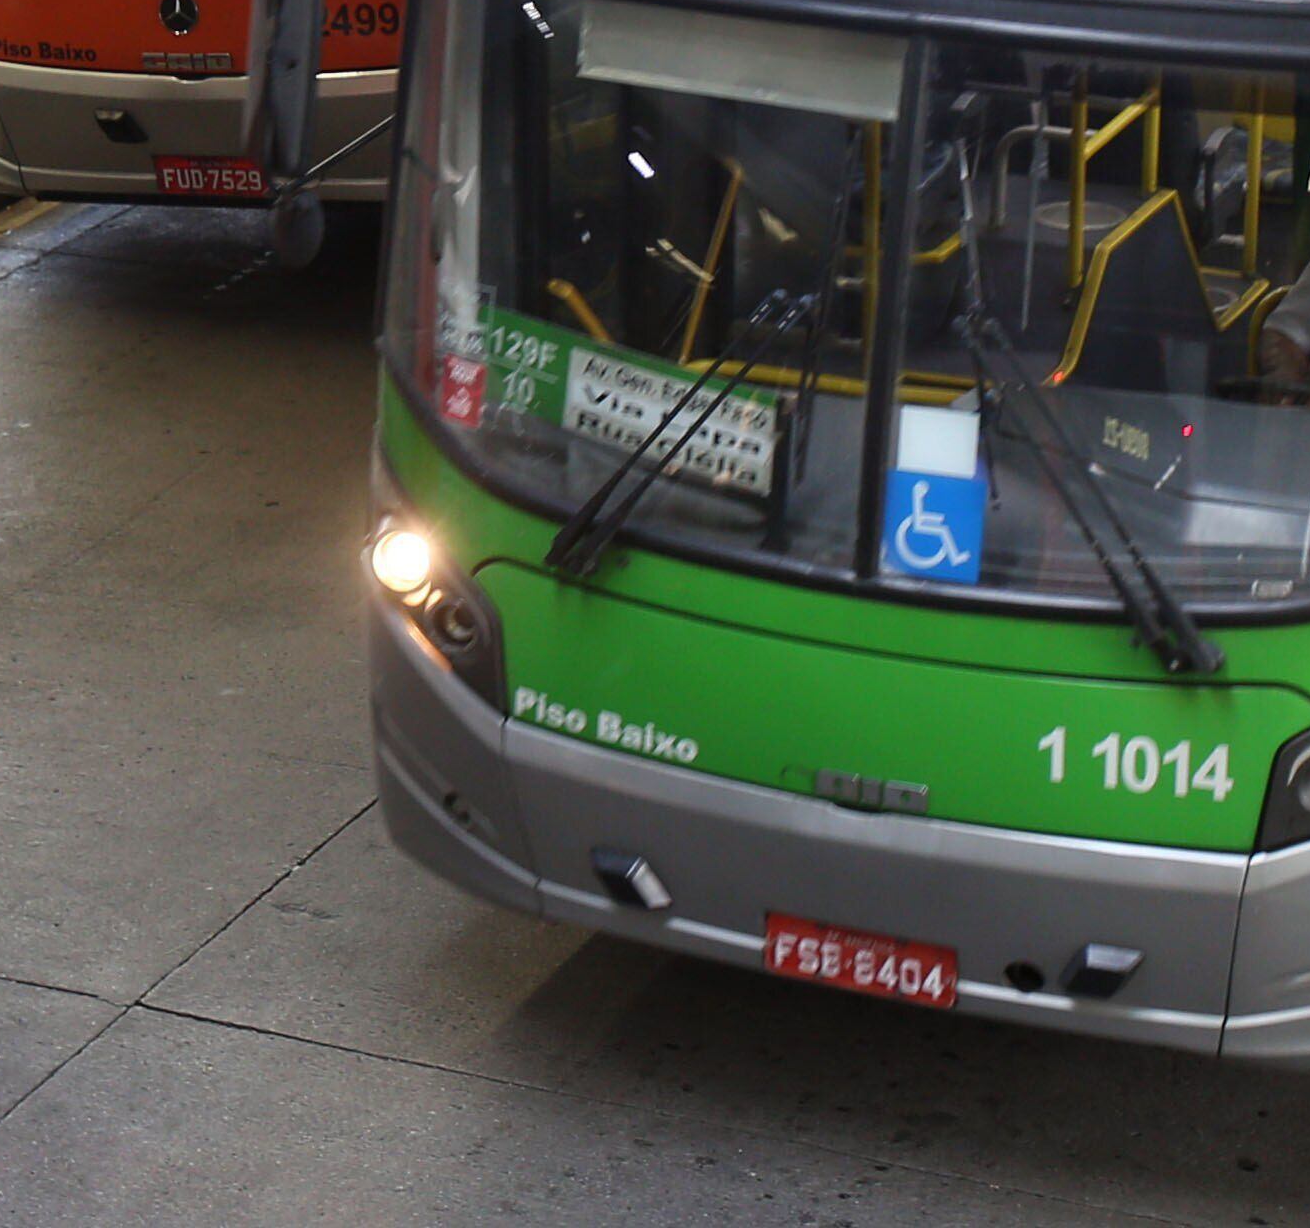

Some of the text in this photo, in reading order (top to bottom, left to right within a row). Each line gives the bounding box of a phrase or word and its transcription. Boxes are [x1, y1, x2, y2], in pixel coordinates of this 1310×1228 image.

[323, 2, 400, 36] 499
[38, 42, 97, 62] Baixo
[491, 326, 559, 370] 129F
[503, 369, 536, 406] 10
[584, 383, 644, 418] Via
[512, 687, 699, 765] Piso Baixo
[1037, 725, 1234, 803] 1 1014
